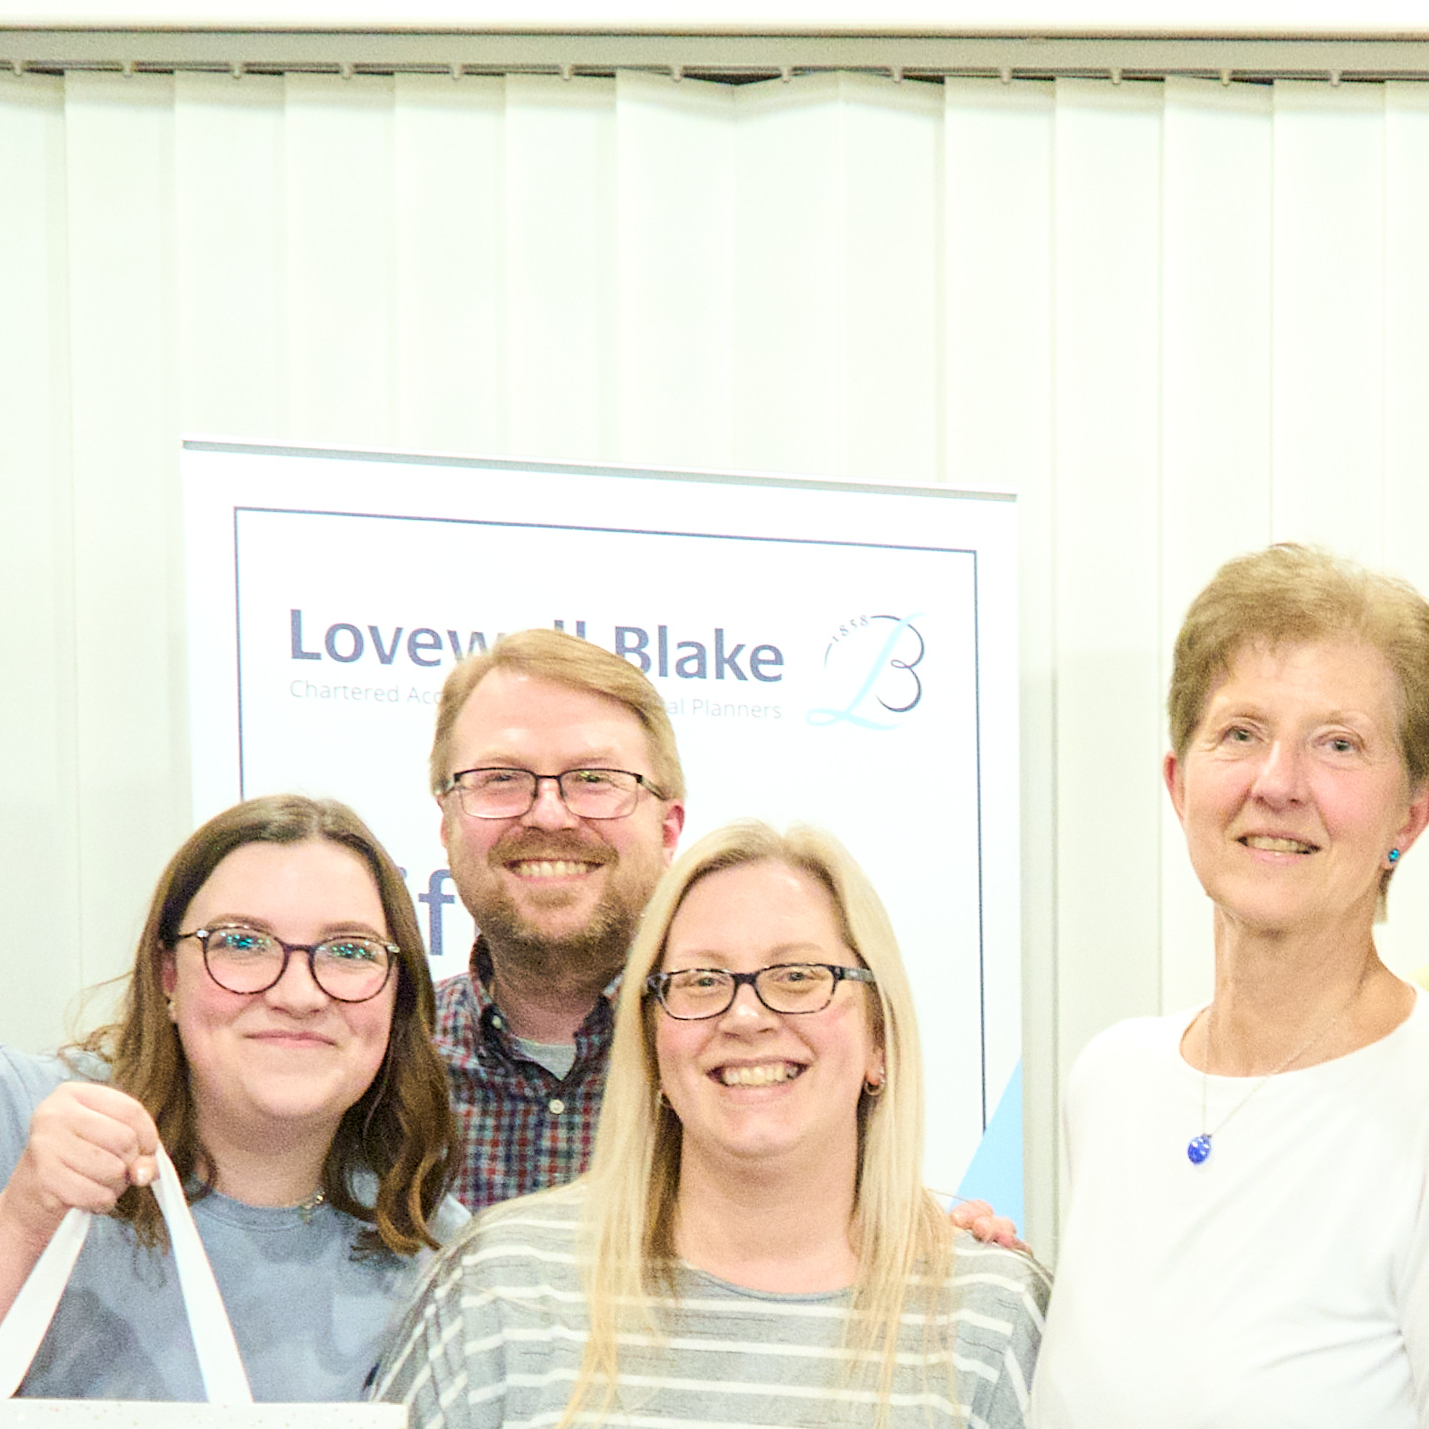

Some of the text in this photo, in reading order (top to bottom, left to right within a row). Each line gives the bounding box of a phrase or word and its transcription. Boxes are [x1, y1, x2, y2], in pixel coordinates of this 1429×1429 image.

[614, 624, 785, 682] Blake
[289, 680, 399, 703] Chartered
[692, 698, 782, 719] Planners
